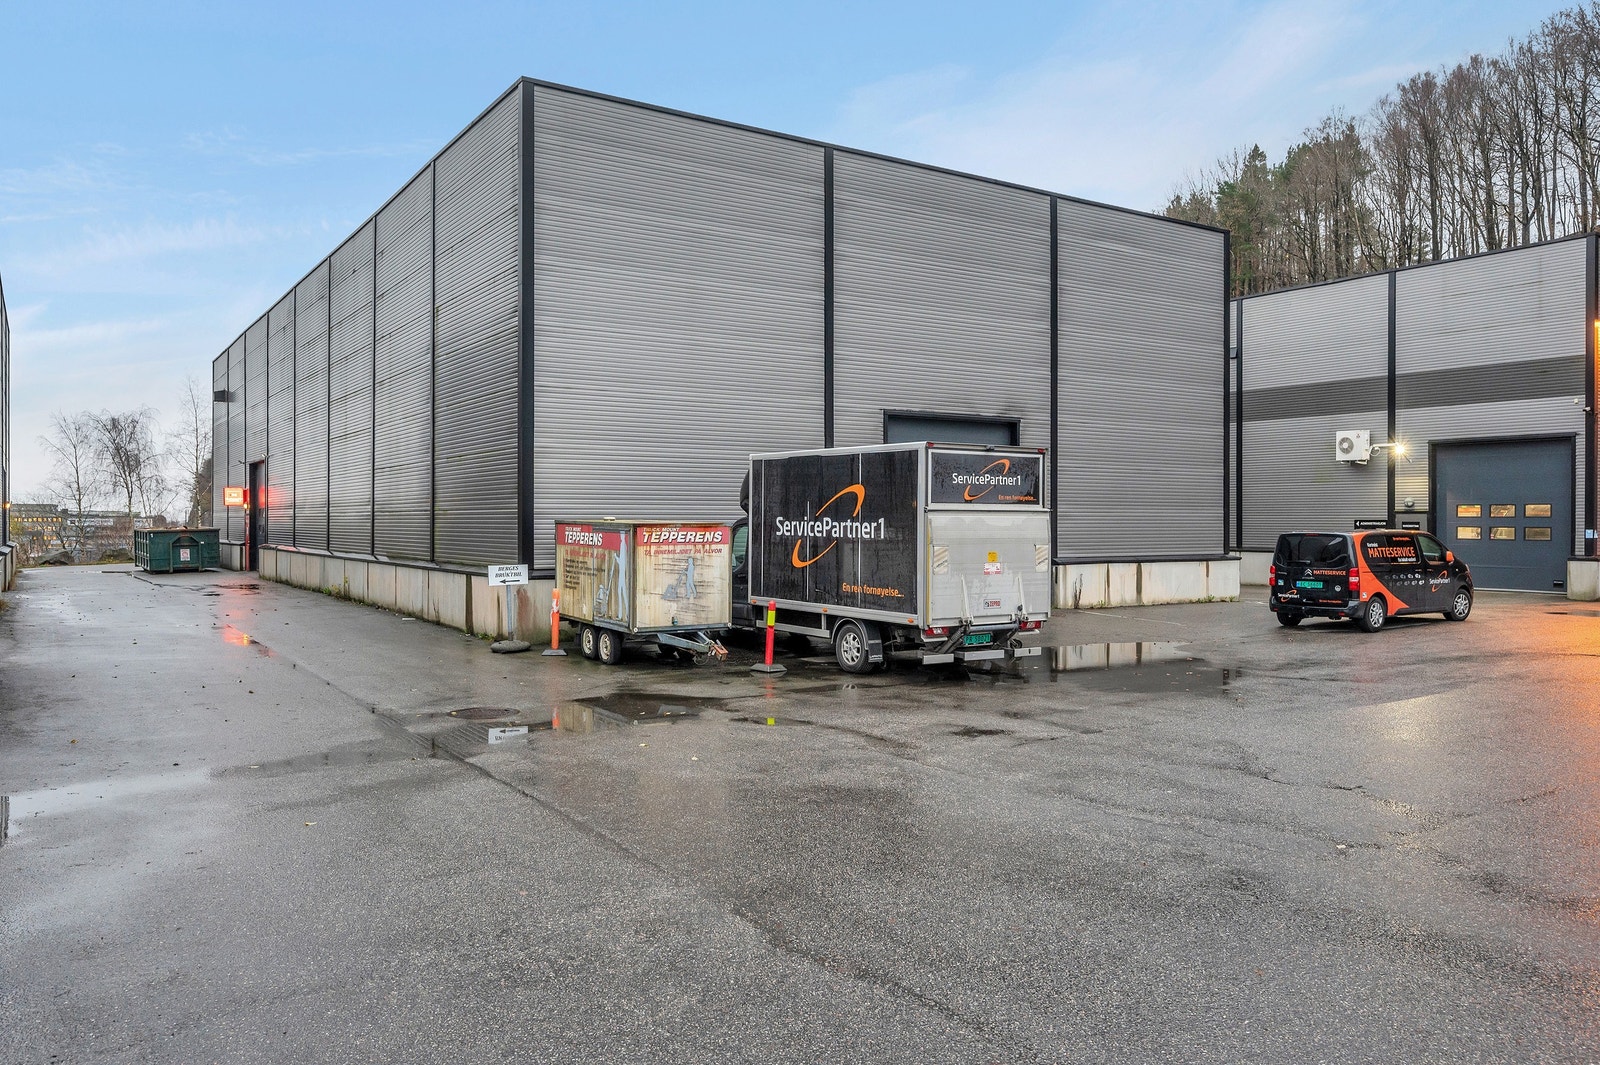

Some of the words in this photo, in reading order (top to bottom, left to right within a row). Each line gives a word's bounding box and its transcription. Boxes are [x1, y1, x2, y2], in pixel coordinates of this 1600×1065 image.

[952, 473, 1021, 486] ServicePartner1
[775, 516, 885, 539] ServicePartner1
[565, 531, 603, 546] TEPPERENS
[643, 531, 723, 543] TEPPERENS
[1367, 546, 1416, 558] MATTESERVICE
[842, 582, 850, 592] En
[851, 584, 863, 593] ren
